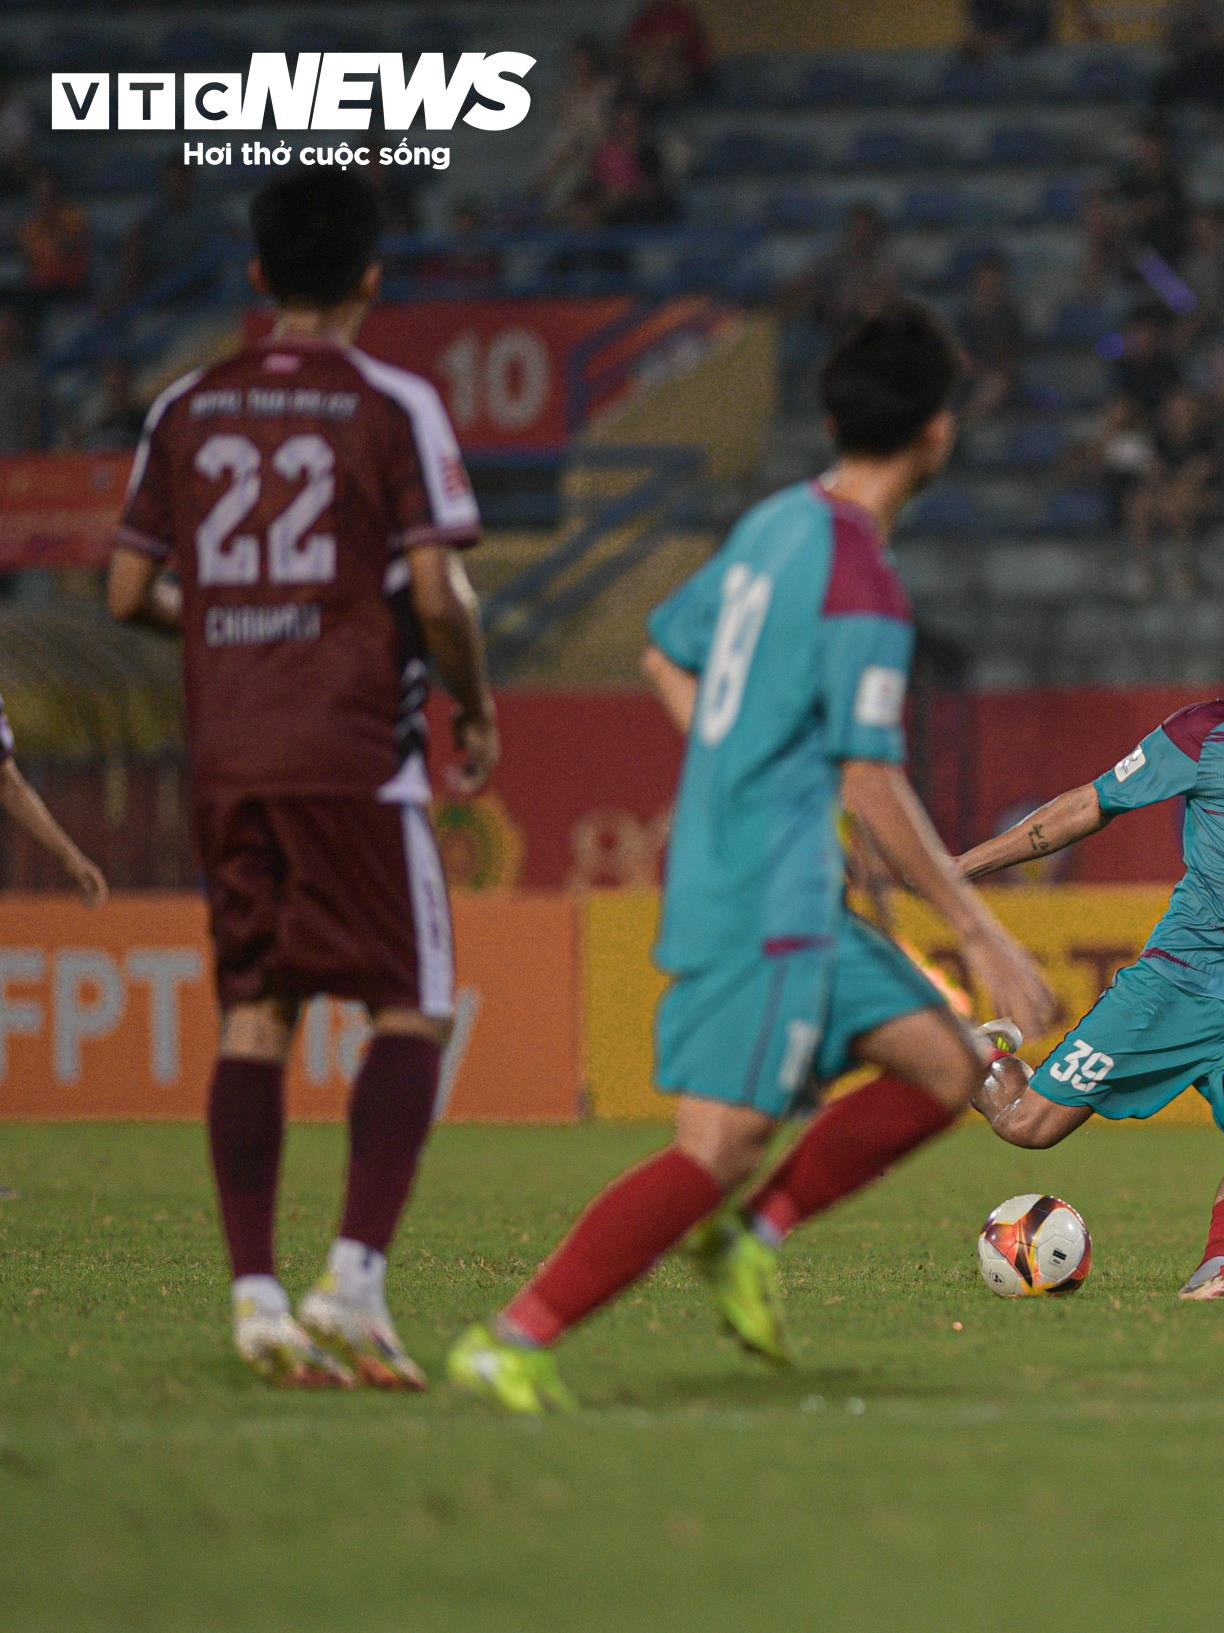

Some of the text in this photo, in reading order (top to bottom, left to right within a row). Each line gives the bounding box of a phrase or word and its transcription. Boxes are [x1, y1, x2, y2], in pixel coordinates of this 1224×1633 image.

[437, 326, 548, 429] 10
[194, 434, 336, 585] 22
[0, 946, 205, 1086] FPT
[1050, 1039, 1114, 1093] 39
